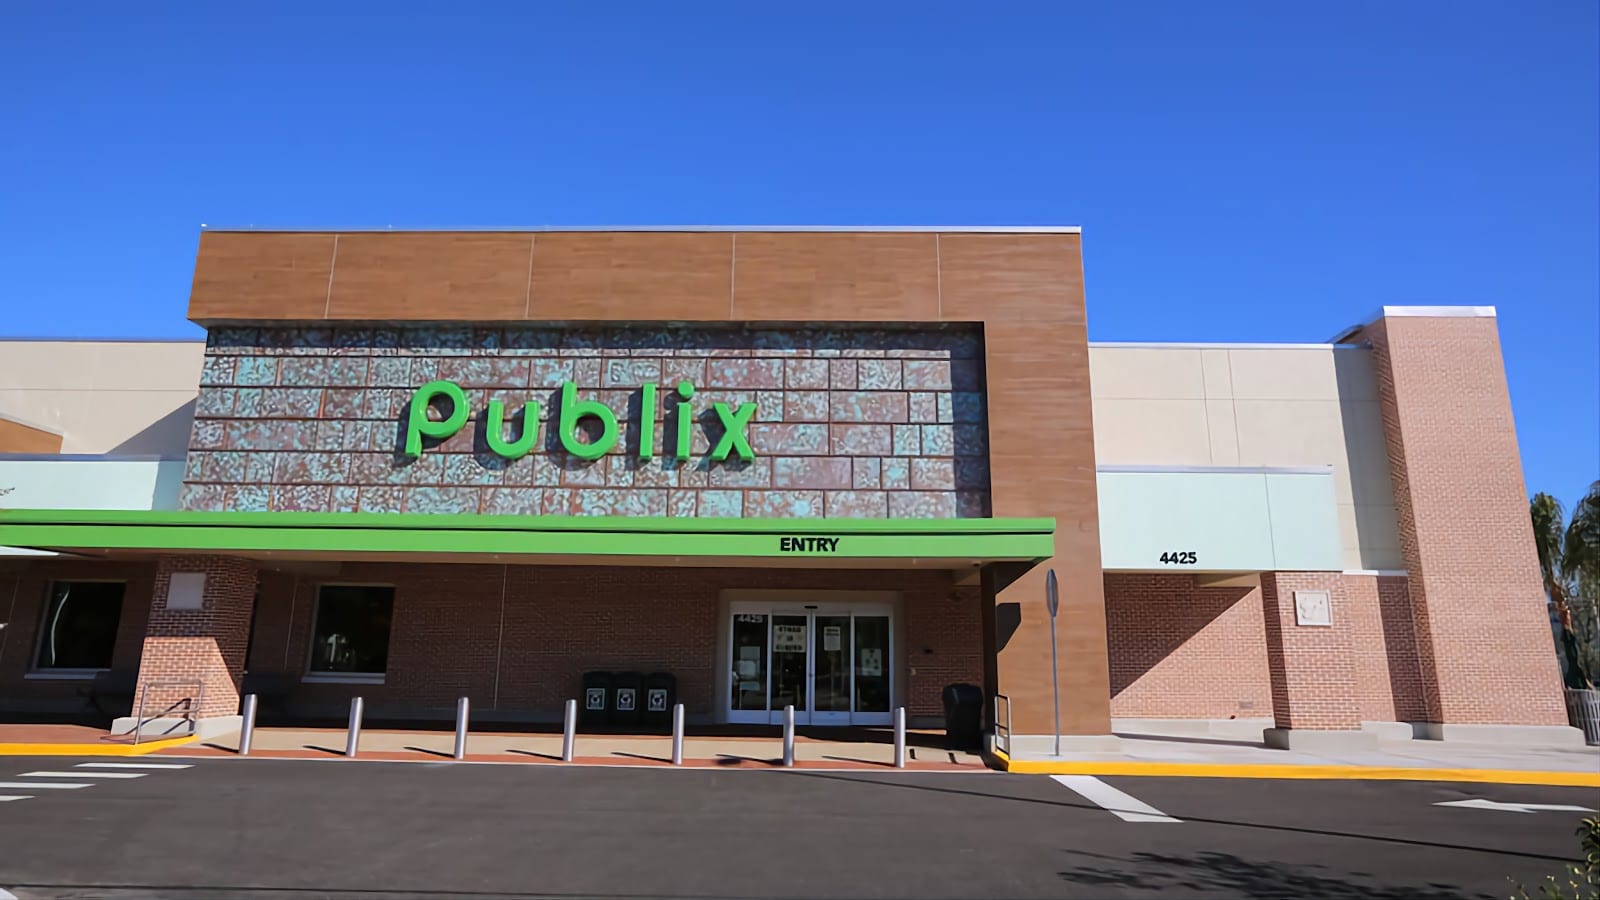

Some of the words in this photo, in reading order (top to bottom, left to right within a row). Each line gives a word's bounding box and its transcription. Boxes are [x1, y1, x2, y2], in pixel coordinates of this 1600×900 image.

[405, 380, 757, 460] Publix
[780, 537, 840, 552] ENTRY
[1159, 551, 1198, 564] 4425
